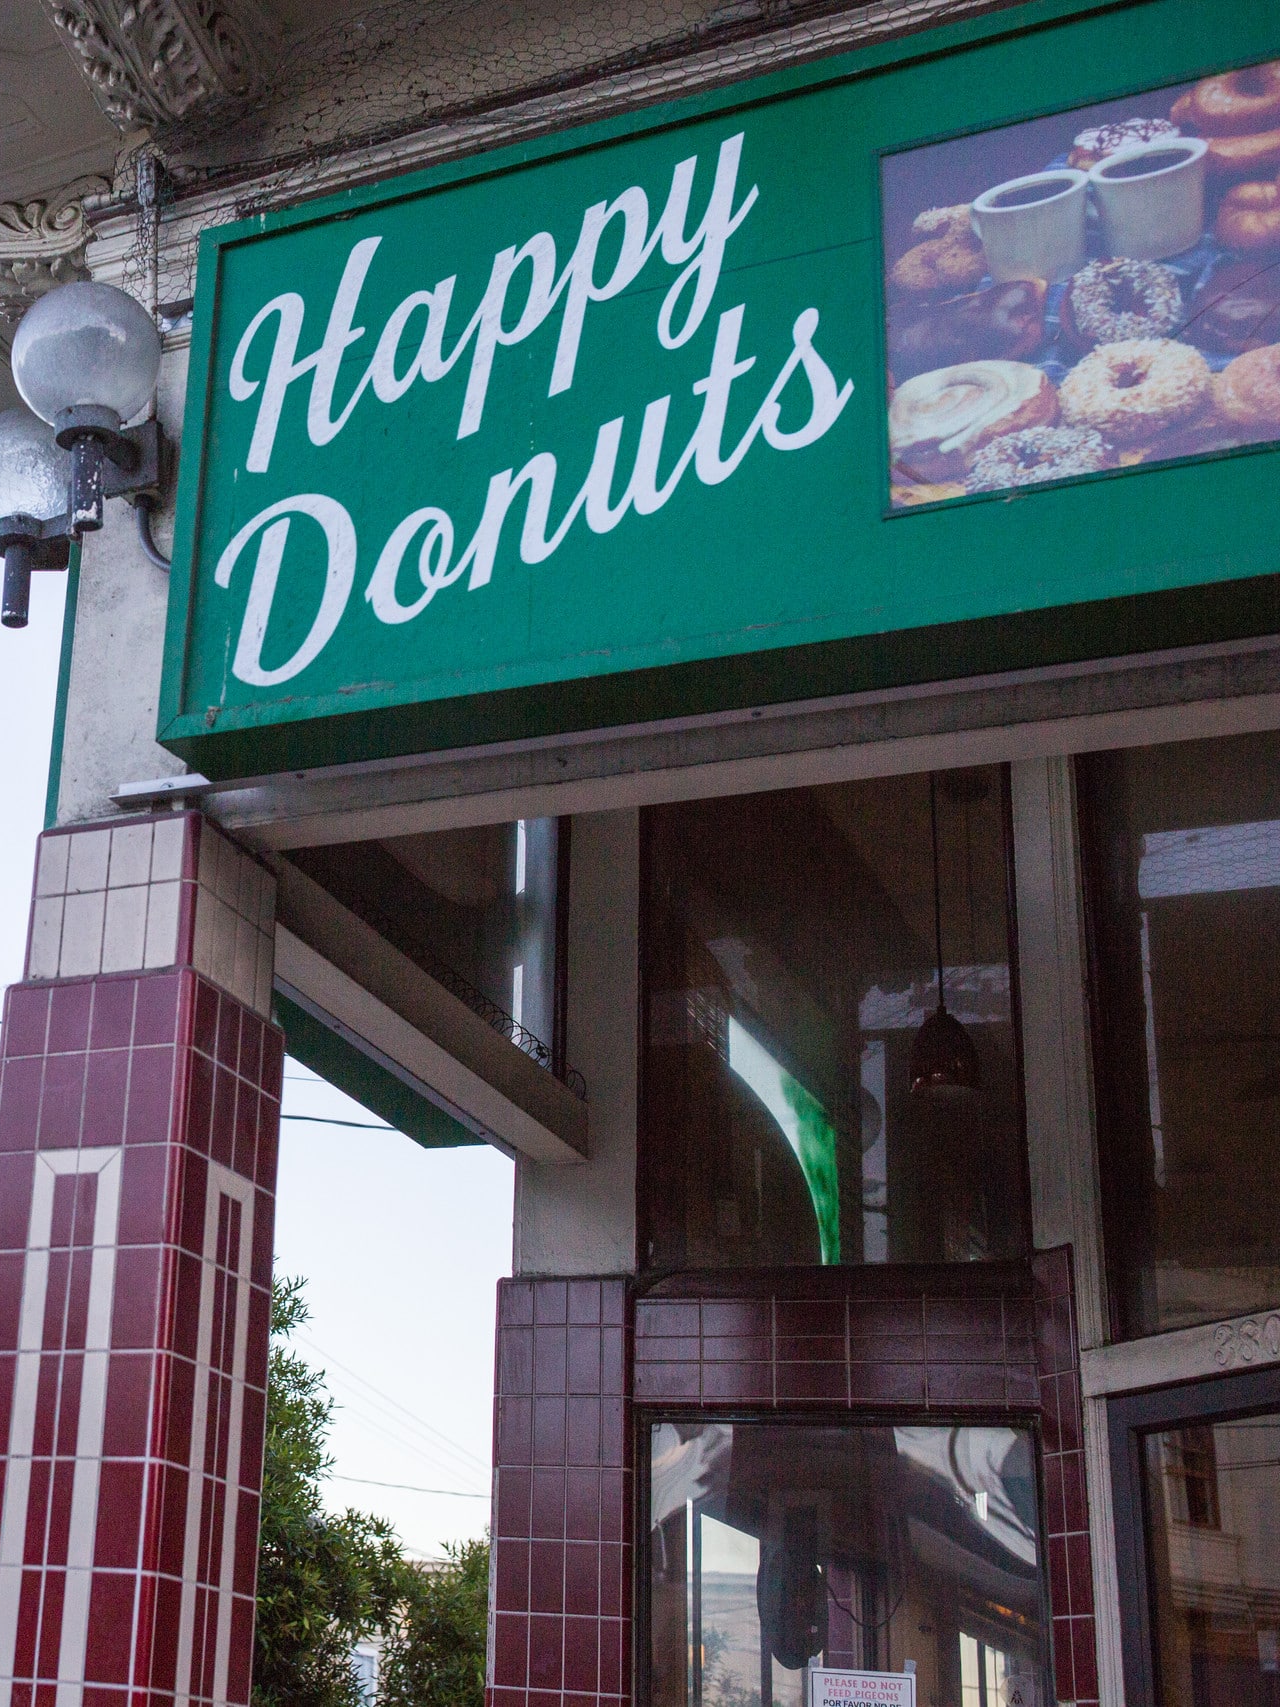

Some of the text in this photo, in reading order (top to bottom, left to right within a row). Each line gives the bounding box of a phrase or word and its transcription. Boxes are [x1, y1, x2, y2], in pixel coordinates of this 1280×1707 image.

[228, 131, 759, 474] Happy
[214, 302, 854, 687] Donuts
[823, 1677, 904, 1691] PLEASE DO NOT
[827, 1688, 900, 1702] FEED PIGEONS
[823, 1699, 841, 1707] POR
